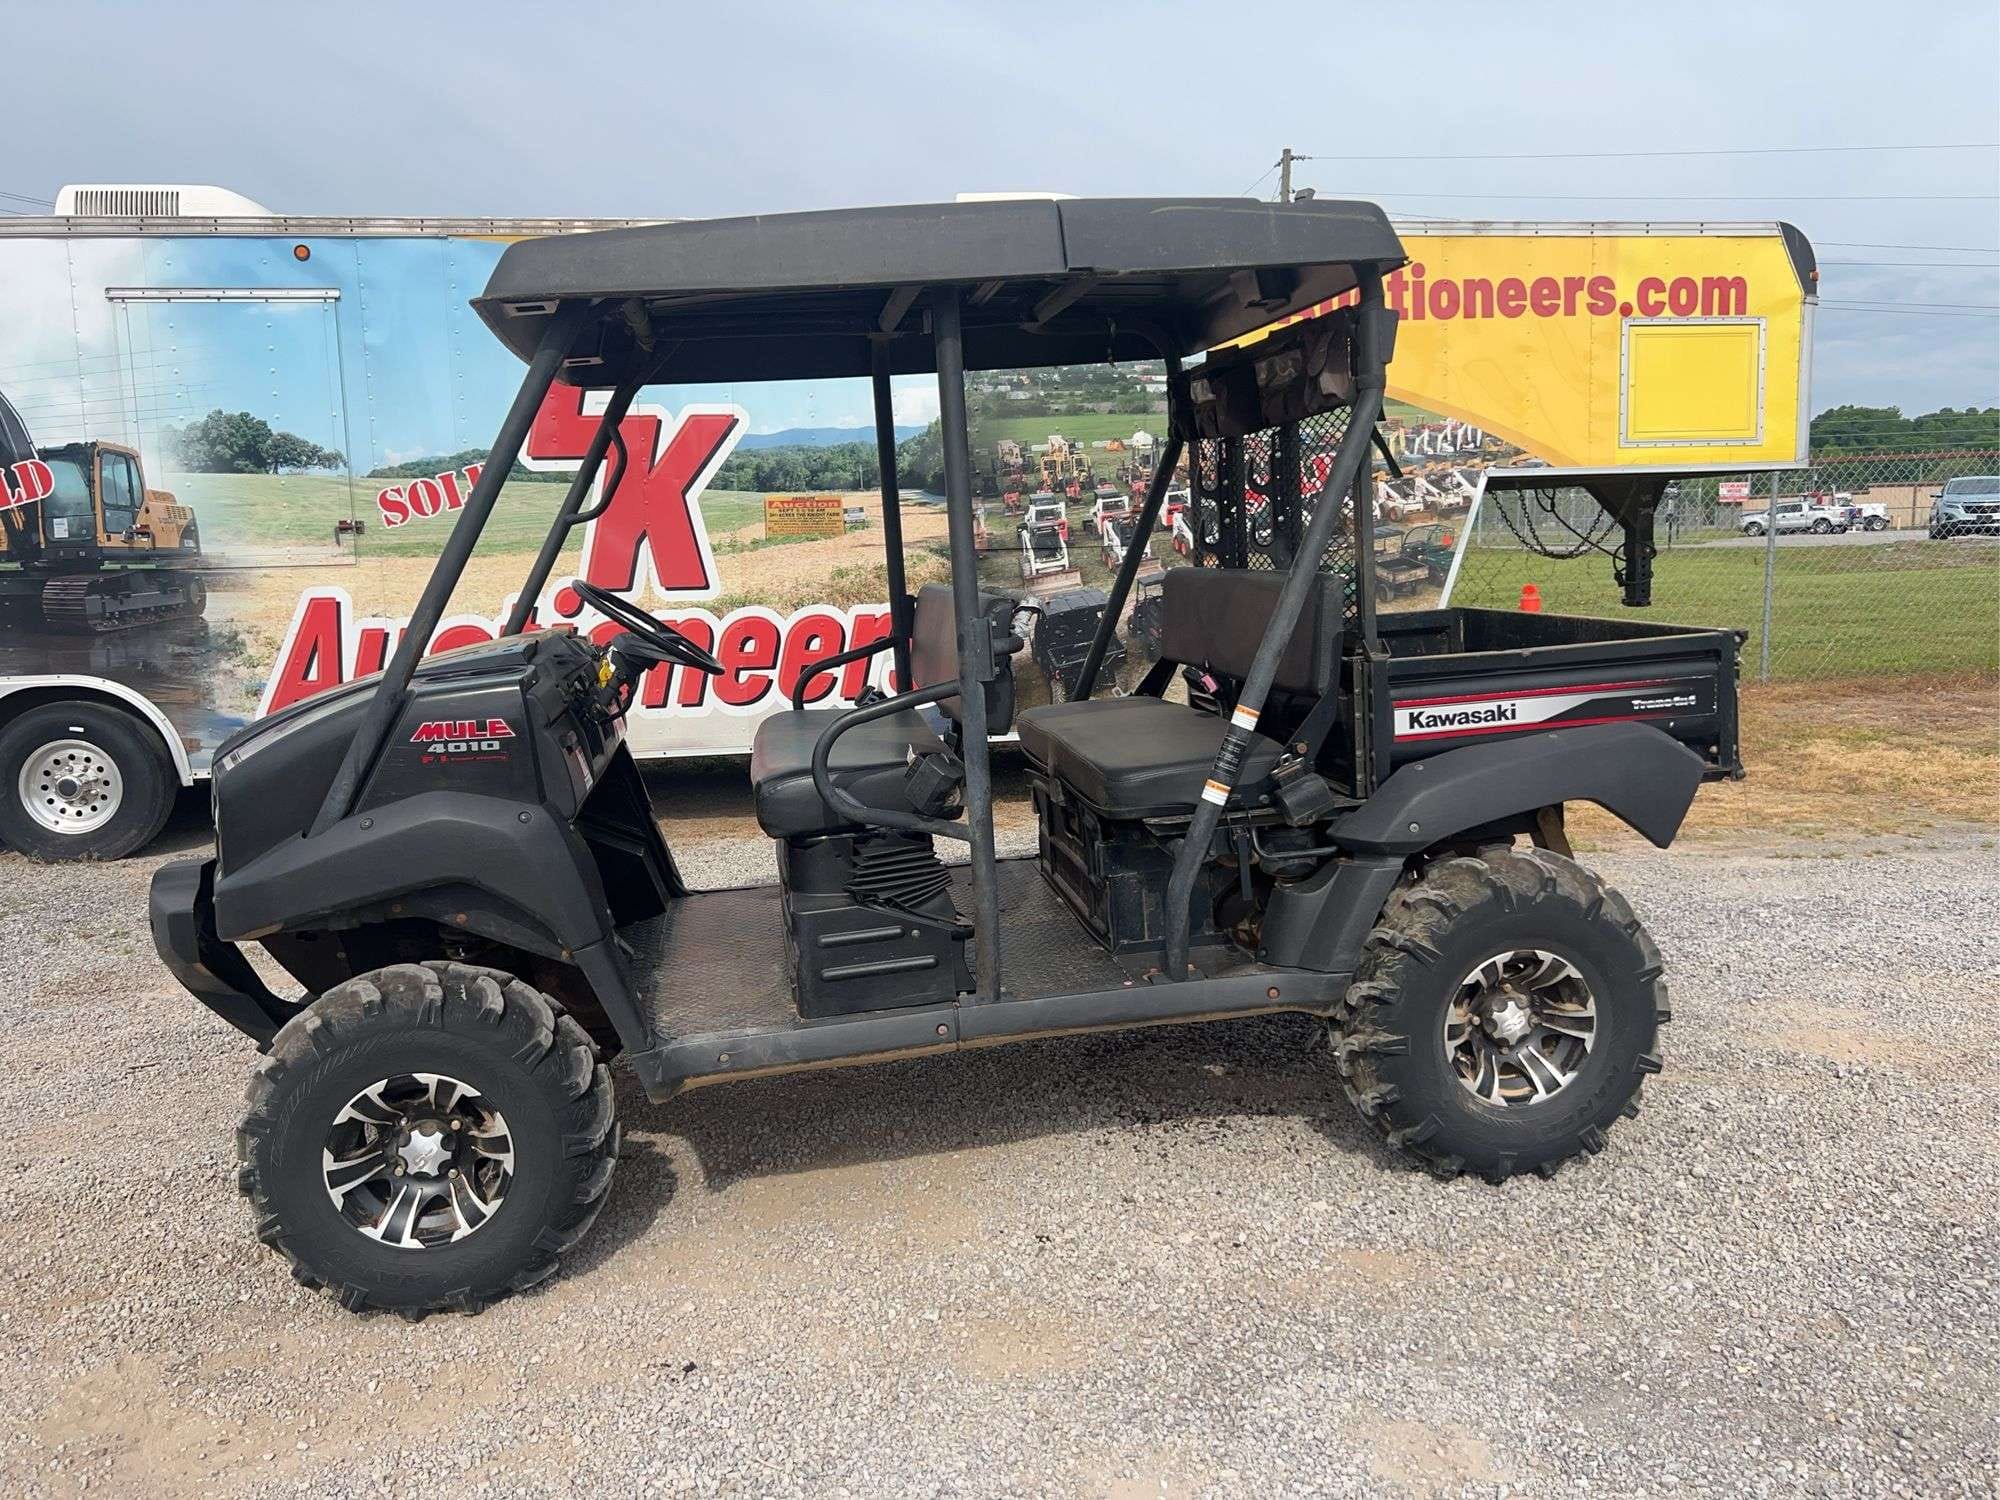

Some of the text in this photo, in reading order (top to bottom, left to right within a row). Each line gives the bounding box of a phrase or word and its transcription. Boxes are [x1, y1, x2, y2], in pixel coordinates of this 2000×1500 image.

[1276, 262, 1748, 325] tioneers.com
[378, 462, 486, 528] SOL
[1408, 703, 1517, 730] Kawasaki
[410, 719, 516, 743] MULE
[427, 740, 501, 753] 4010
